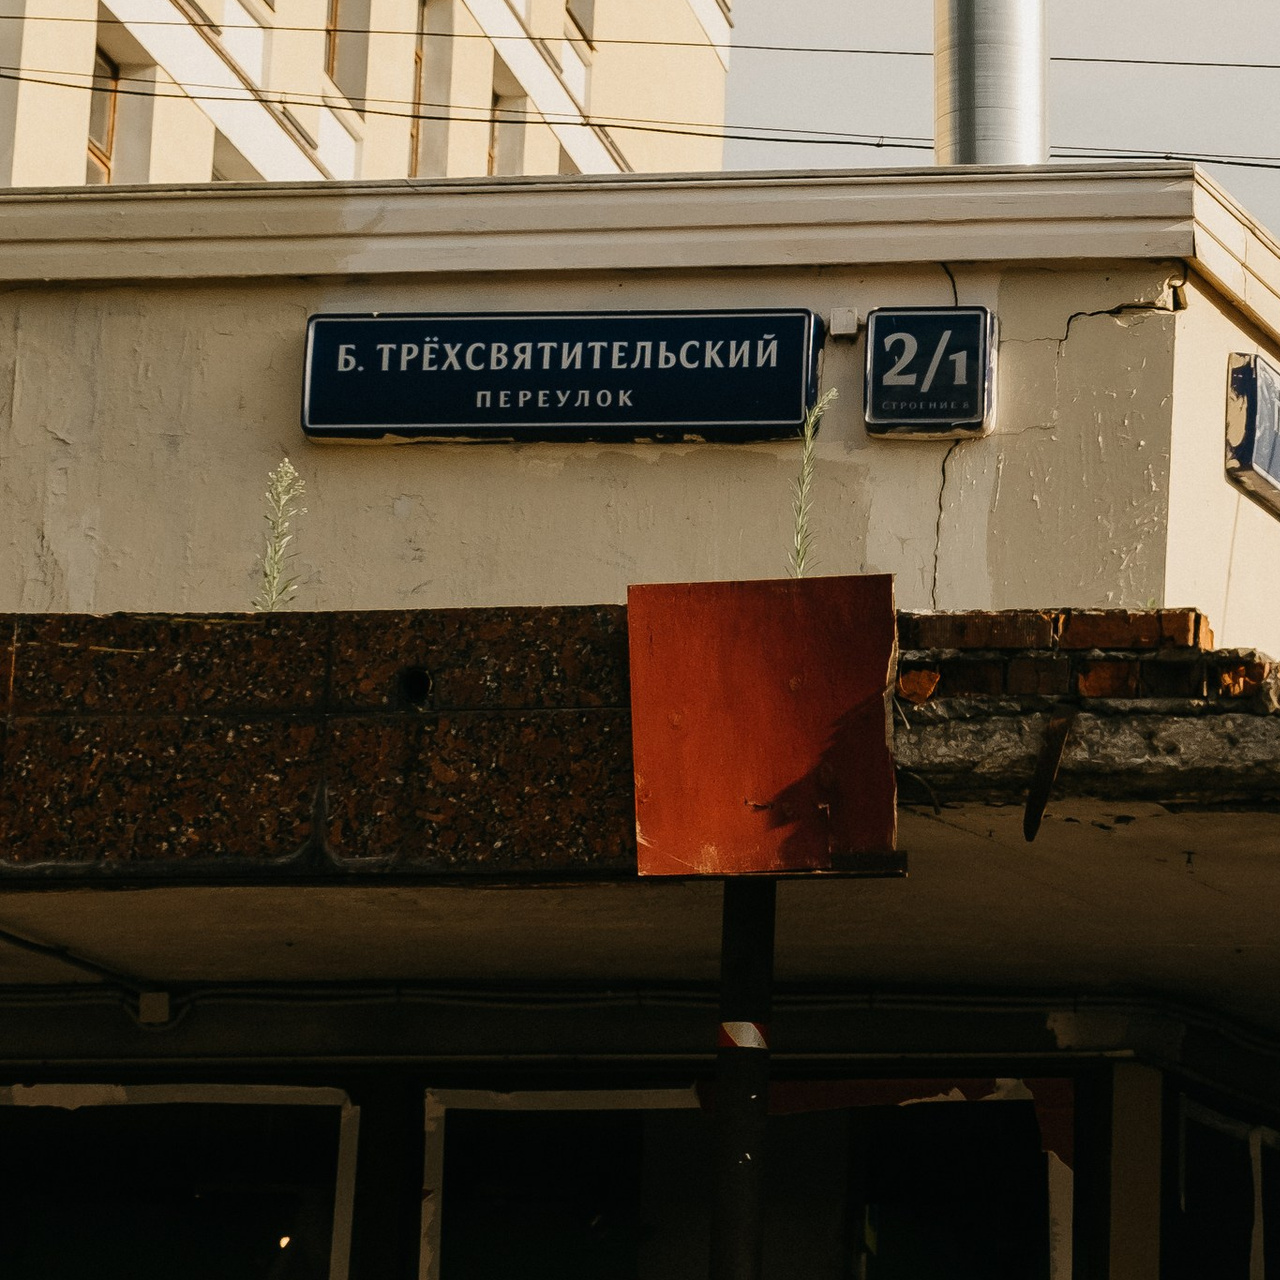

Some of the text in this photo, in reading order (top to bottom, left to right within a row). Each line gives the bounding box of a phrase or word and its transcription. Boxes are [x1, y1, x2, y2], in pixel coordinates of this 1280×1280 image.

[337, 334, 780, 372] Б. ТРЁХСВЯТИТЕЛЬСКИЙ
[882, 330, 968, 393] 2/1
[476, 389, 634, 408] ПЕРЕУЛОК
[882, 401, 958, 410] СТРОЕНИЕ
